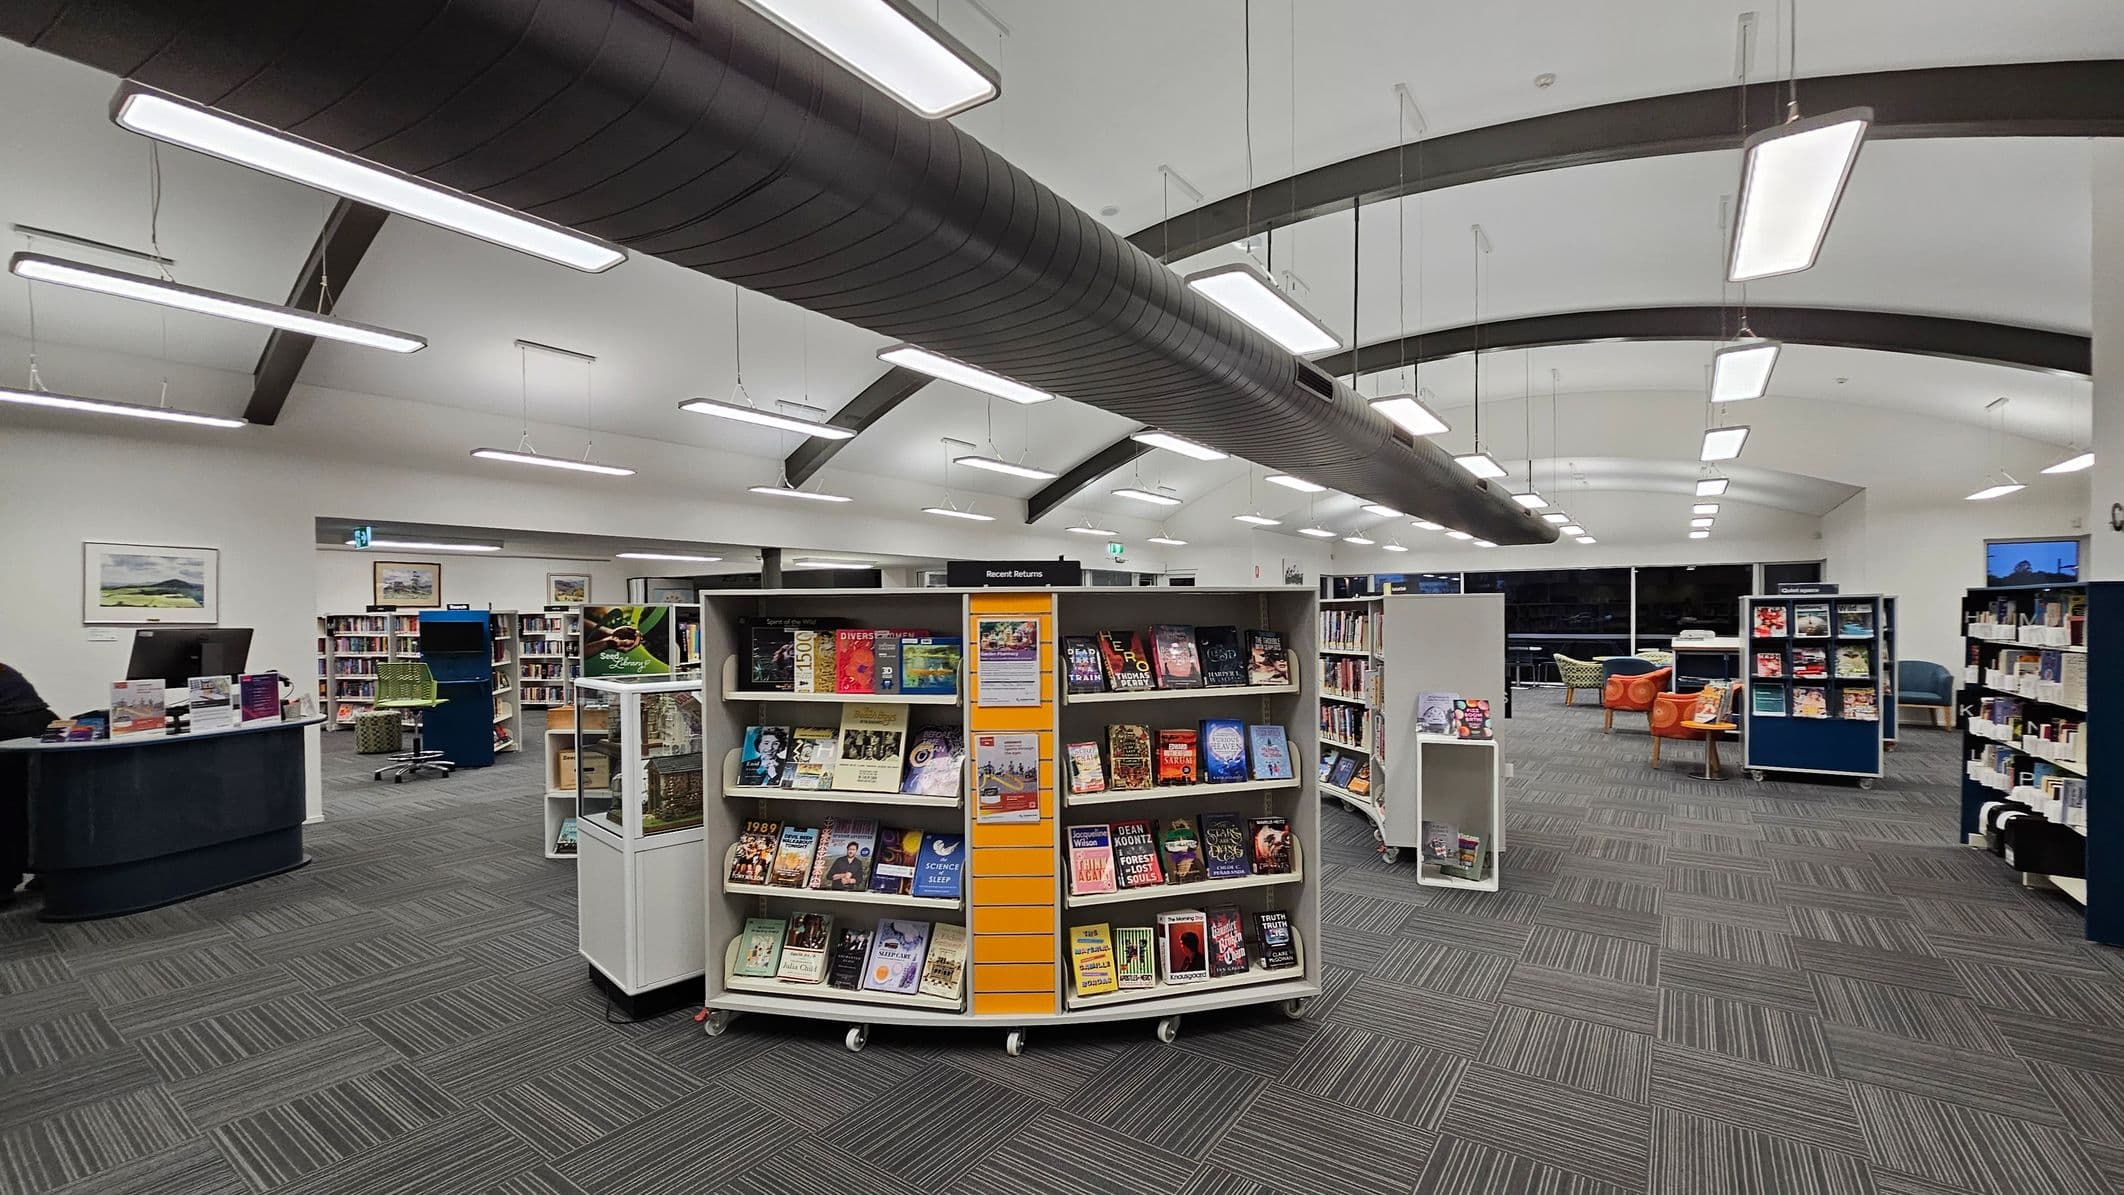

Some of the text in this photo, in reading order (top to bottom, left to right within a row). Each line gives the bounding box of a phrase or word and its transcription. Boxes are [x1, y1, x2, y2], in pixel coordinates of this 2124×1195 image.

[986, 570, 1043, 578] Recent Returns
[766, 618, 783, 626] Spirit
[600, 652, 620, 660] Seed
[1069, 656, 1097, 664] TAKE
[608, 656, 646, 673] Library
[1114, 672, 1151, 680] THOMAS
[1121, 679, 1150, 687] PERRY
[1960, 704, 1974, 716] K
[855, 711, 878, 719] Beach
[878, 712, 897, 726] Boys
[923, 730, 950, 739] BEFORE
[1212, 735, 1240, 744] FURIOUS
[1210, 742, 1242, 751] HEAVEN
[1163, 756, 1193, 765] SARUM
[2020, 771, 2034, 786] P
[746, 821, 778, 833] 1989
[1118, 824, 1145, 836] DEAN
[1072, 828, 1107, 840] Jacqueline
[1073, 838, 1099, 847] Wilson
[1114, 834, 1153, 848] KOONTZ
[785, 842, 809, 850] TONIGHT
[1077, 857, 1108, 870] THINK
[1120, 854, 1154, 866] FOREST
[925, 862, 960, 871] SCIENCE
[1131, 863, 1153, 874] LOST
[928, 875, 952, 884] SLEEP
[1078, 868, 1109, 882] AGAIN
[1126, 873, 1158, 884] SOULS
[1261, 913, 1286, 922] TRUTH
[1262, 921, 1288, 930] TRUTH
[878, 950, 911, 960] SLEEP CARE
[782, 961, 799, 971] Julia
[1170, 972, 1207, 980] Knausgaard
